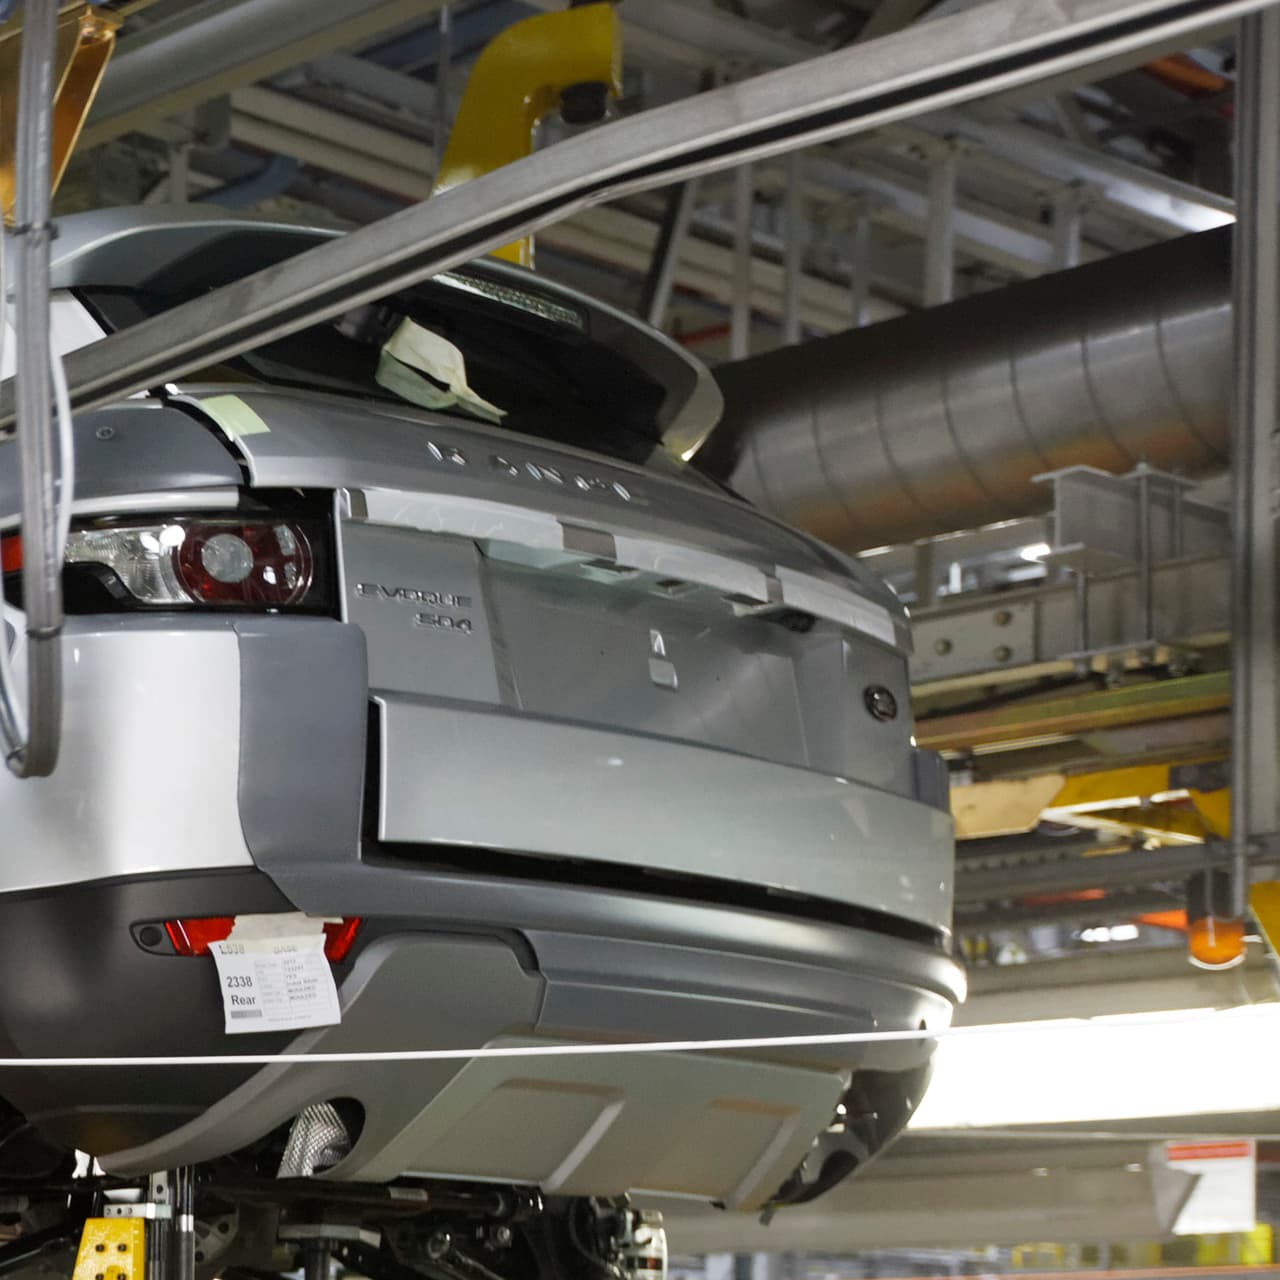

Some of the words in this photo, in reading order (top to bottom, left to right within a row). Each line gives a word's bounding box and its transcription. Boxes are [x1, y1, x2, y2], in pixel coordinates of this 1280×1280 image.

[356, 583, 472, 608] EVOQUE
[226, 975, 253, 988] 2338
[231, 994, 256, 1006] Rear
